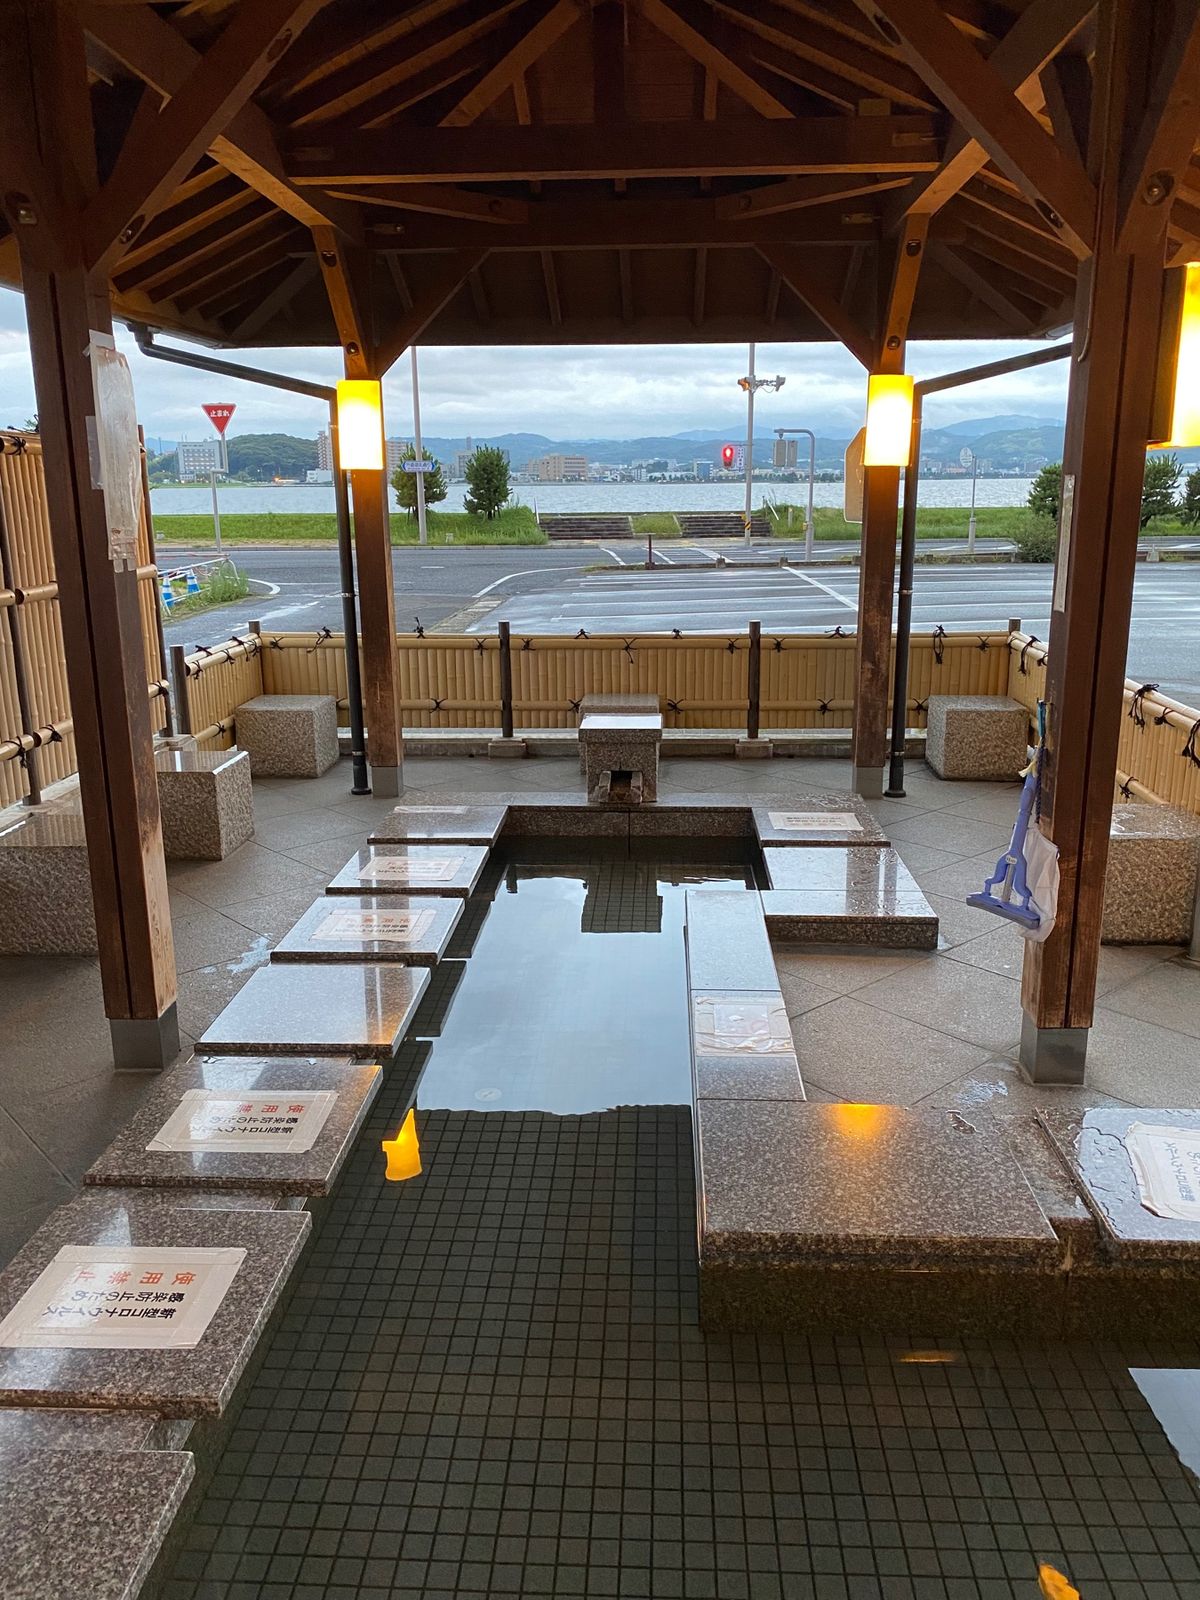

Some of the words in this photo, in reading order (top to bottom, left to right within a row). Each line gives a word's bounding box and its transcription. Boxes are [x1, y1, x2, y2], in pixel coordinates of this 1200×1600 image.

[210, 409, 230, 417] 止まれ
[209, 1104, 305, 1114] 使用禁
[72, 1270, 197, 1286] 使用禁止
[71, 1290, 186, 1303] 感染防止のため
[42, 1304, 177, 1320] 新型コロナウイルス
